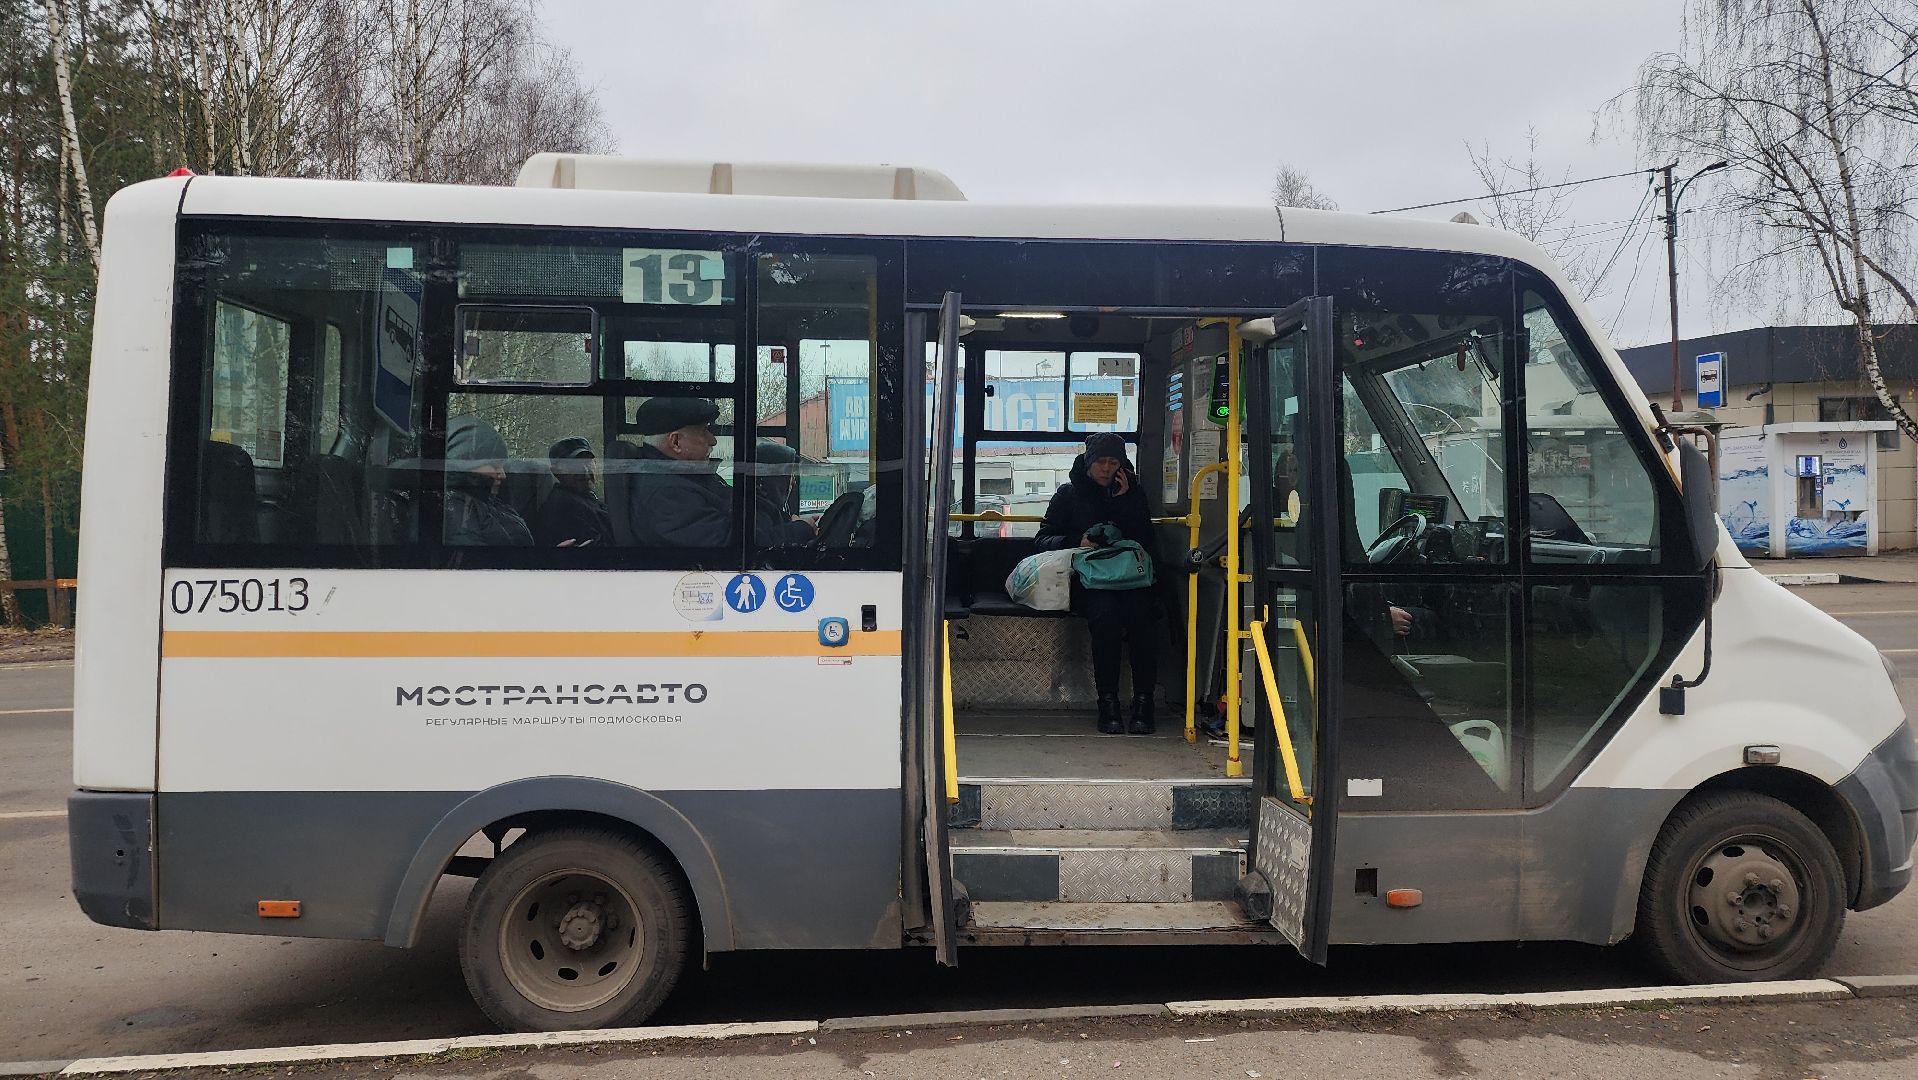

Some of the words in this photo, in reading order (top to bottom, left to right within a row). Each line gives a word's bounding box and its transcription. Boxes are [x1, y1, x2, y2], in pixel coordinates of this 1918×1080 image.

[630, 254, 713, 304] 13
[171, 577, 309, 614] 075013
[396, 683, 708, 706] МОСТРАНСАВТО
[426, 717, 508, 726] РЕГУЛЯРНЫЕ
[513, 716, 585, 725] МАРШРУТЫ
[589, 715, 682, 725] ПОДМОСКОВЬЯ
